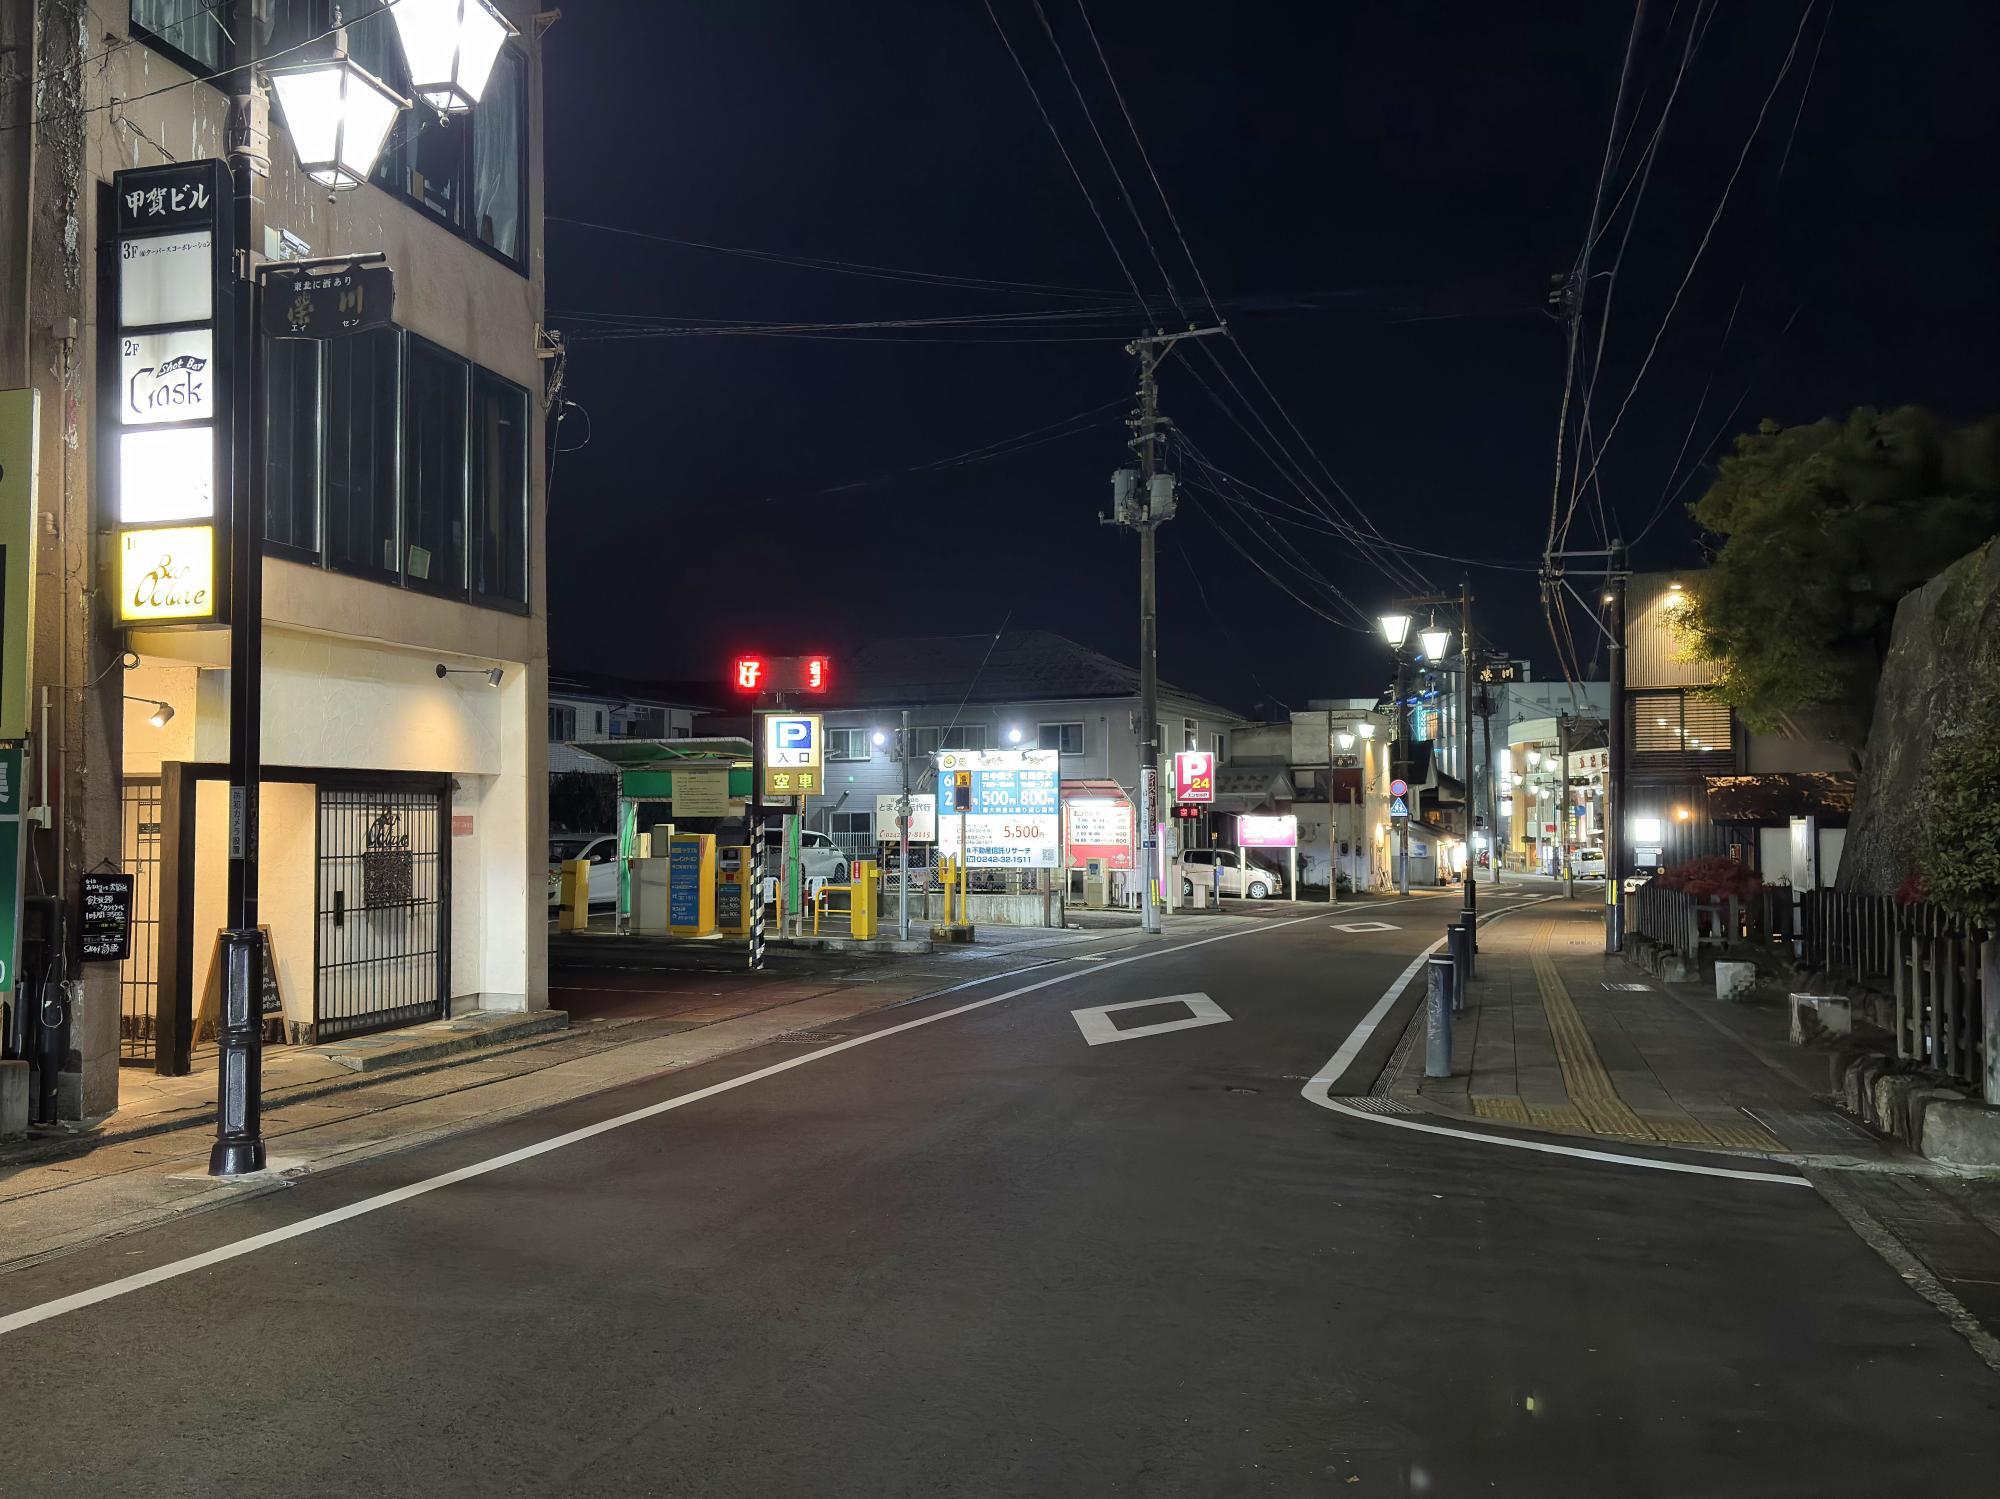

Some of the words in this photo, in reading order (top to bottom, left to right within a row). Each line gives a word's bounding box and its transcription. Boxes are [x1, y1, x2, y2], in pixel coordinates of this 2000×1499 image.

[125, 183, 210, 218] 甲賀ビル
[123, 242, 139, 260] 3F
[293, 276, 352, 292] 東北に酒あり
[124, 339, 140, 357] 2F
[162, 358, 184, 374] Shot
[186, 358, 204, 372] Bar
[779, 722, 807, 748] P
[777, 752, 810, 764] 入口
[1182, 755, 1208, 785] P
[773, 772, 813, 789] 空車
[1192, 777, 1210, 789] 24
[232, 791, 241, 855] 防犯カメラ設置
[976, 855, 1031, 863] 0242-32-1511
